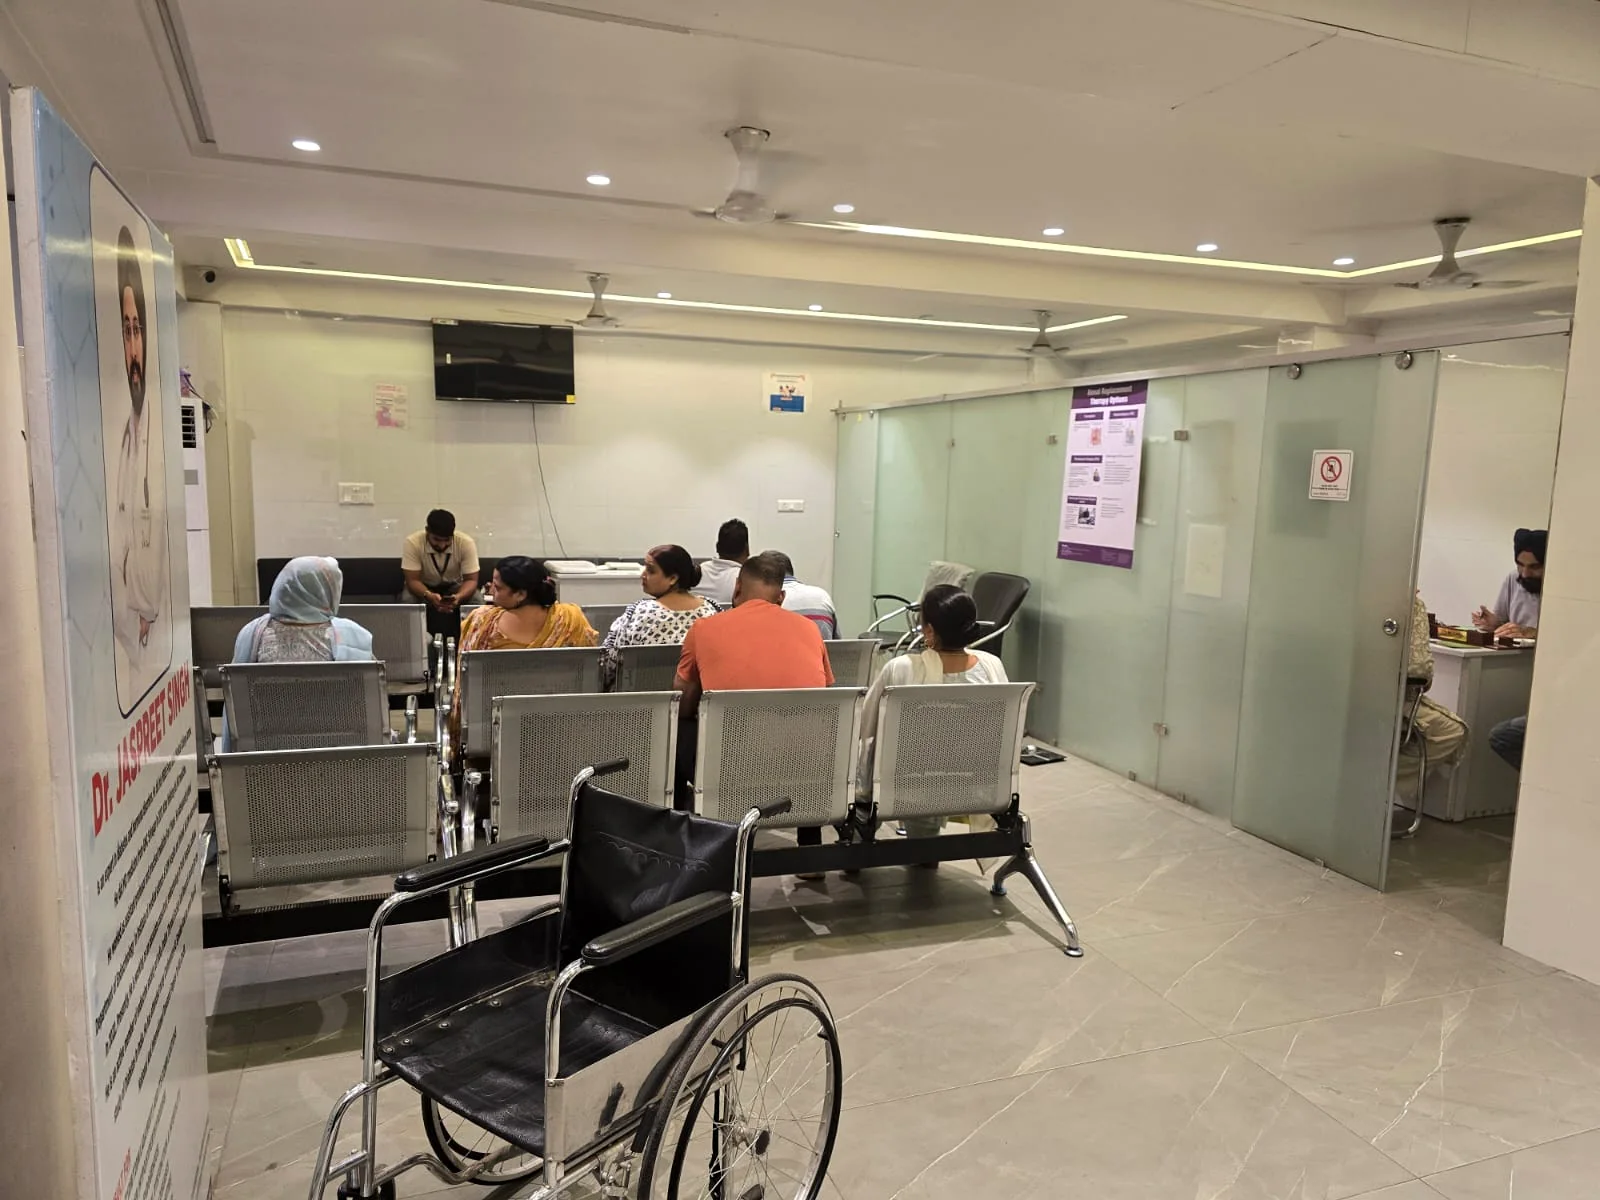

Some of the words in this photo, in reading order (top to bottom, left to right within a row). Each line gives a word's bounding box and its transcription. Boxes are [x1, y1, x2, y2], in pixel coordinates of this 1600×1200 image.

[1090, 397, 1109, 406] Therapy
[1109, 396, 1128, 405] Options
[92, 772, 113, 837] Dr.
[116, 688, 166, 804] JASPREET
[167, 660, 190, 727] SINGH
